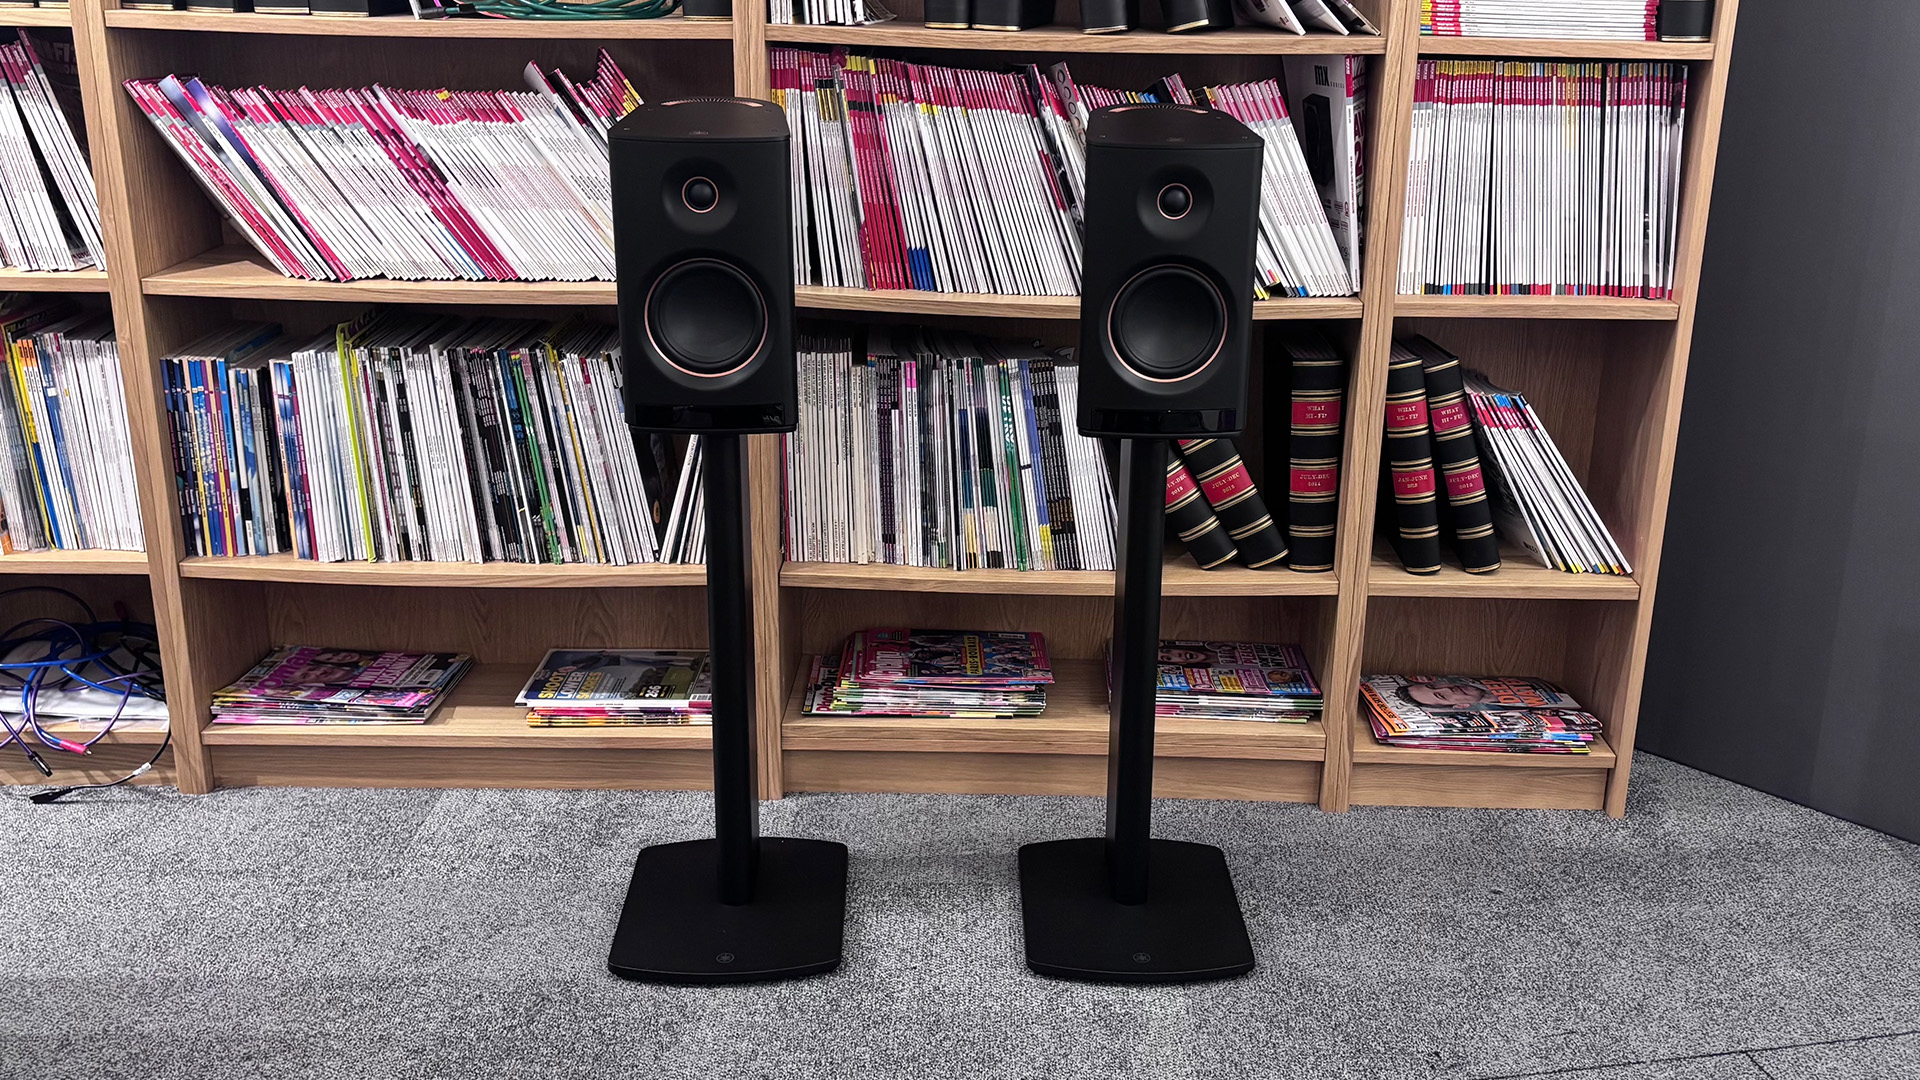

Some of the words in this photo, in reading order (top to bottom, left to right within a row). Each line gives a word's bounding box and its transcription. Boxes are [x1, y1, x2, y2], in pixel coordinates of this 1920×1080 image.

[1441, 406, 1460, 416] WHAT
[1212, 472, 1240, 489] JULY-DEC
[538, 668, 567, 699] SHOOT
[556, 671, 586, 699] LOWER
[576, 671, 602, 699] SCORES
[645, 685, 662, 698] 266
[1480, 679, 1514, 704] DEEP
